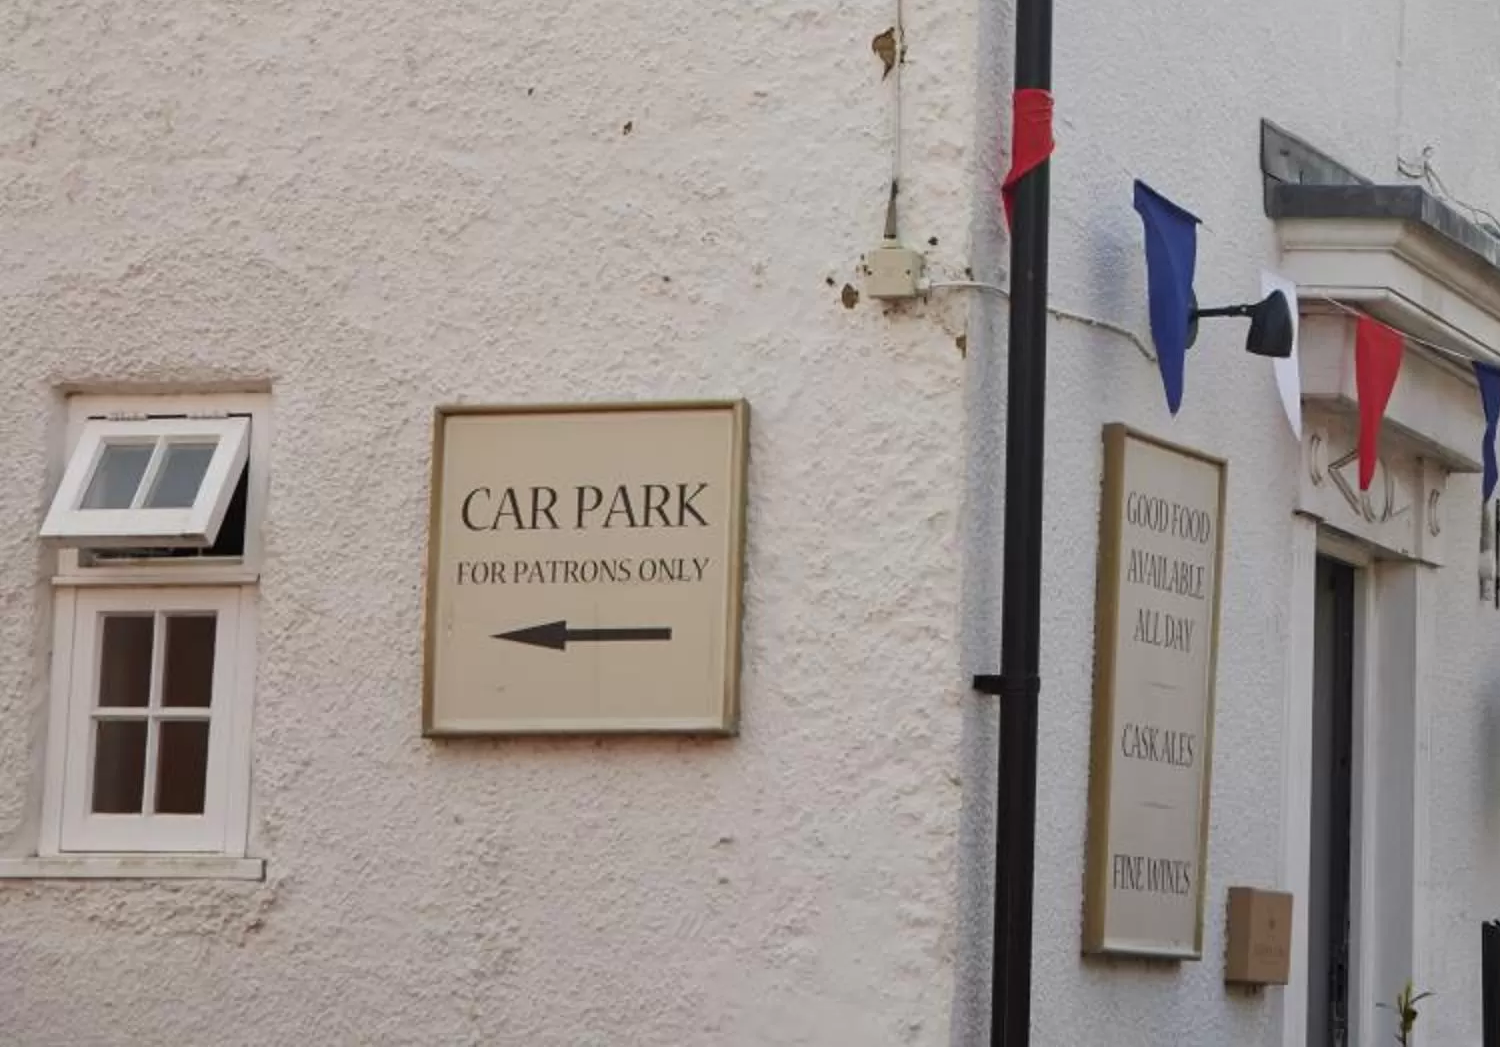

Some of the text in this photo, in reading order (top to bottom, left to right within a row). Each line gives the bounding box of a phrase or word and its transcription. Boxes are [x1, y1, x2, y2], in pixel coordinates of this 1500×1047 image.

[461, 481, 710, 532] CAR PARK
[1127, 491, 1211, 544] GOOD FOOD
[456, 556, 711, 586] FOR PATRONS ONLY
[1127, 548, 1205, 600] AVAILABLE
[1133, 608, 1195, 653] ALL DAY
[1121, 722, 1196, 768] CASK ALES
[1113, 854, 1192, 894] FINE WINES
